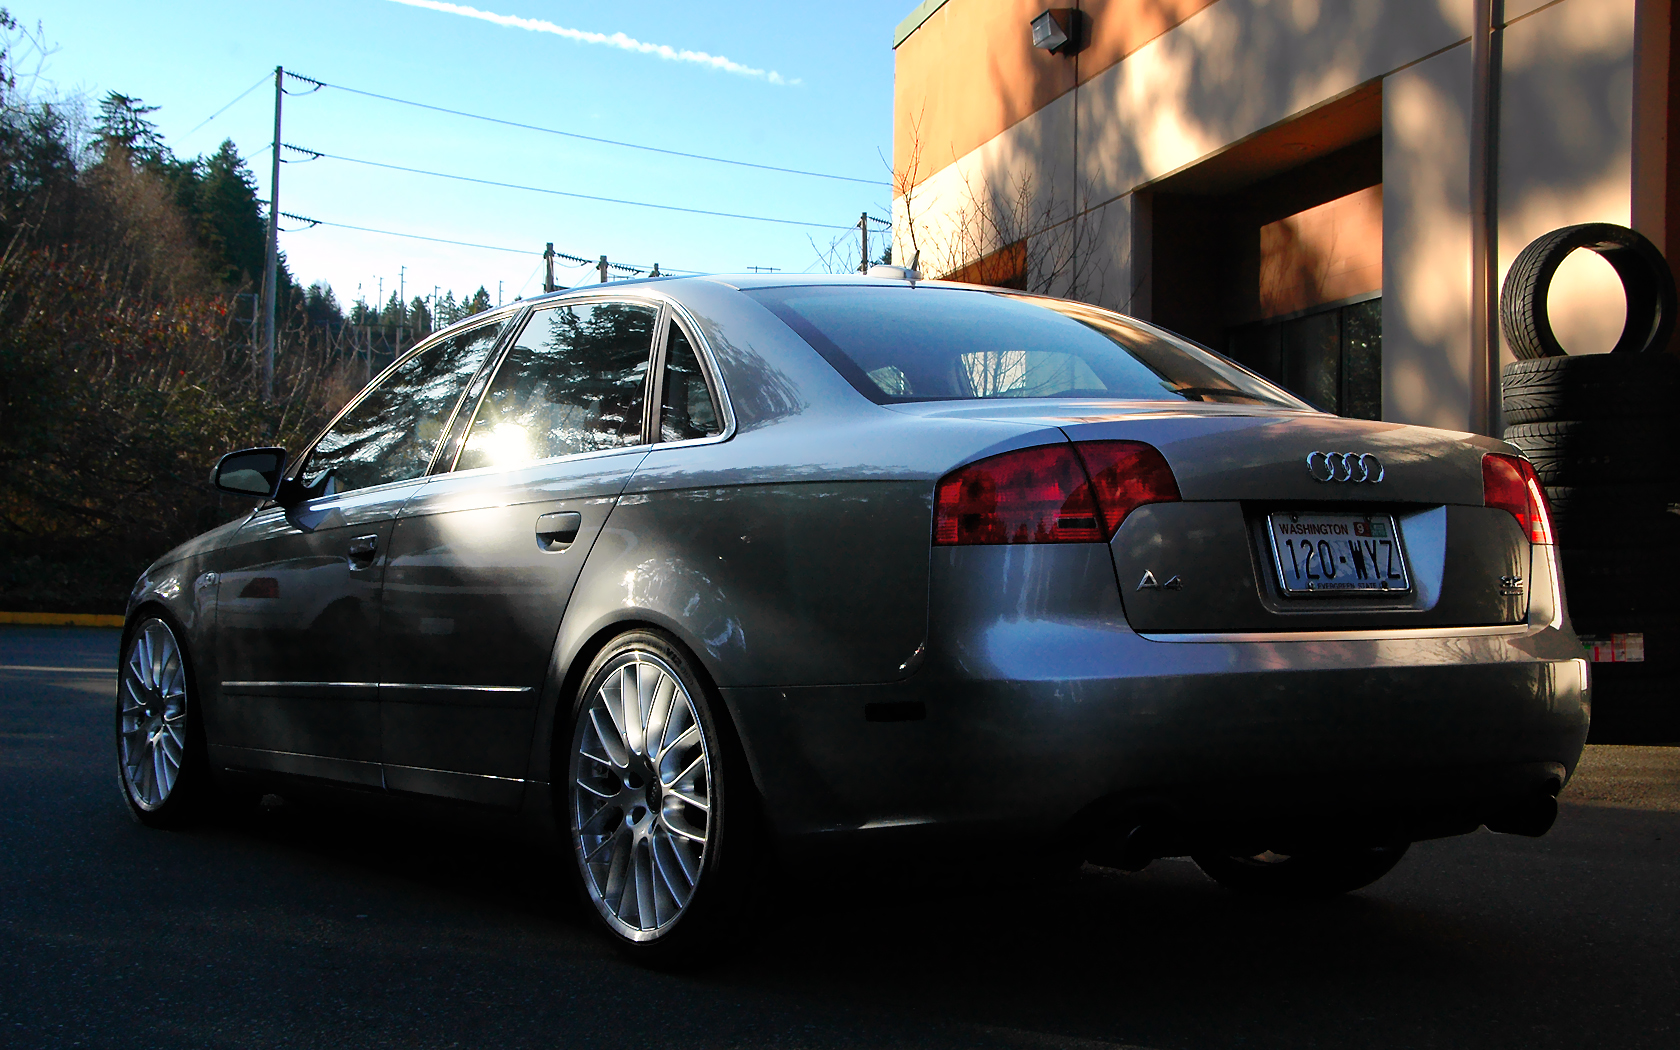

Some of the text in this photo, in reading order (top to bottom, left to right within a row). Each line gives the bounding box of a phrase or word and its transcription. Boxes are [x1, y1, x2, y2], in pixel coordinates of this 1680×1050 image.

[1278, 523, 1349, 535] WASHINGTON
[1356, 523, 1365, 534] 9
[1136, 569, 1183, 591] A4
[1317, 582, 1355, 590] EVERGREEN
